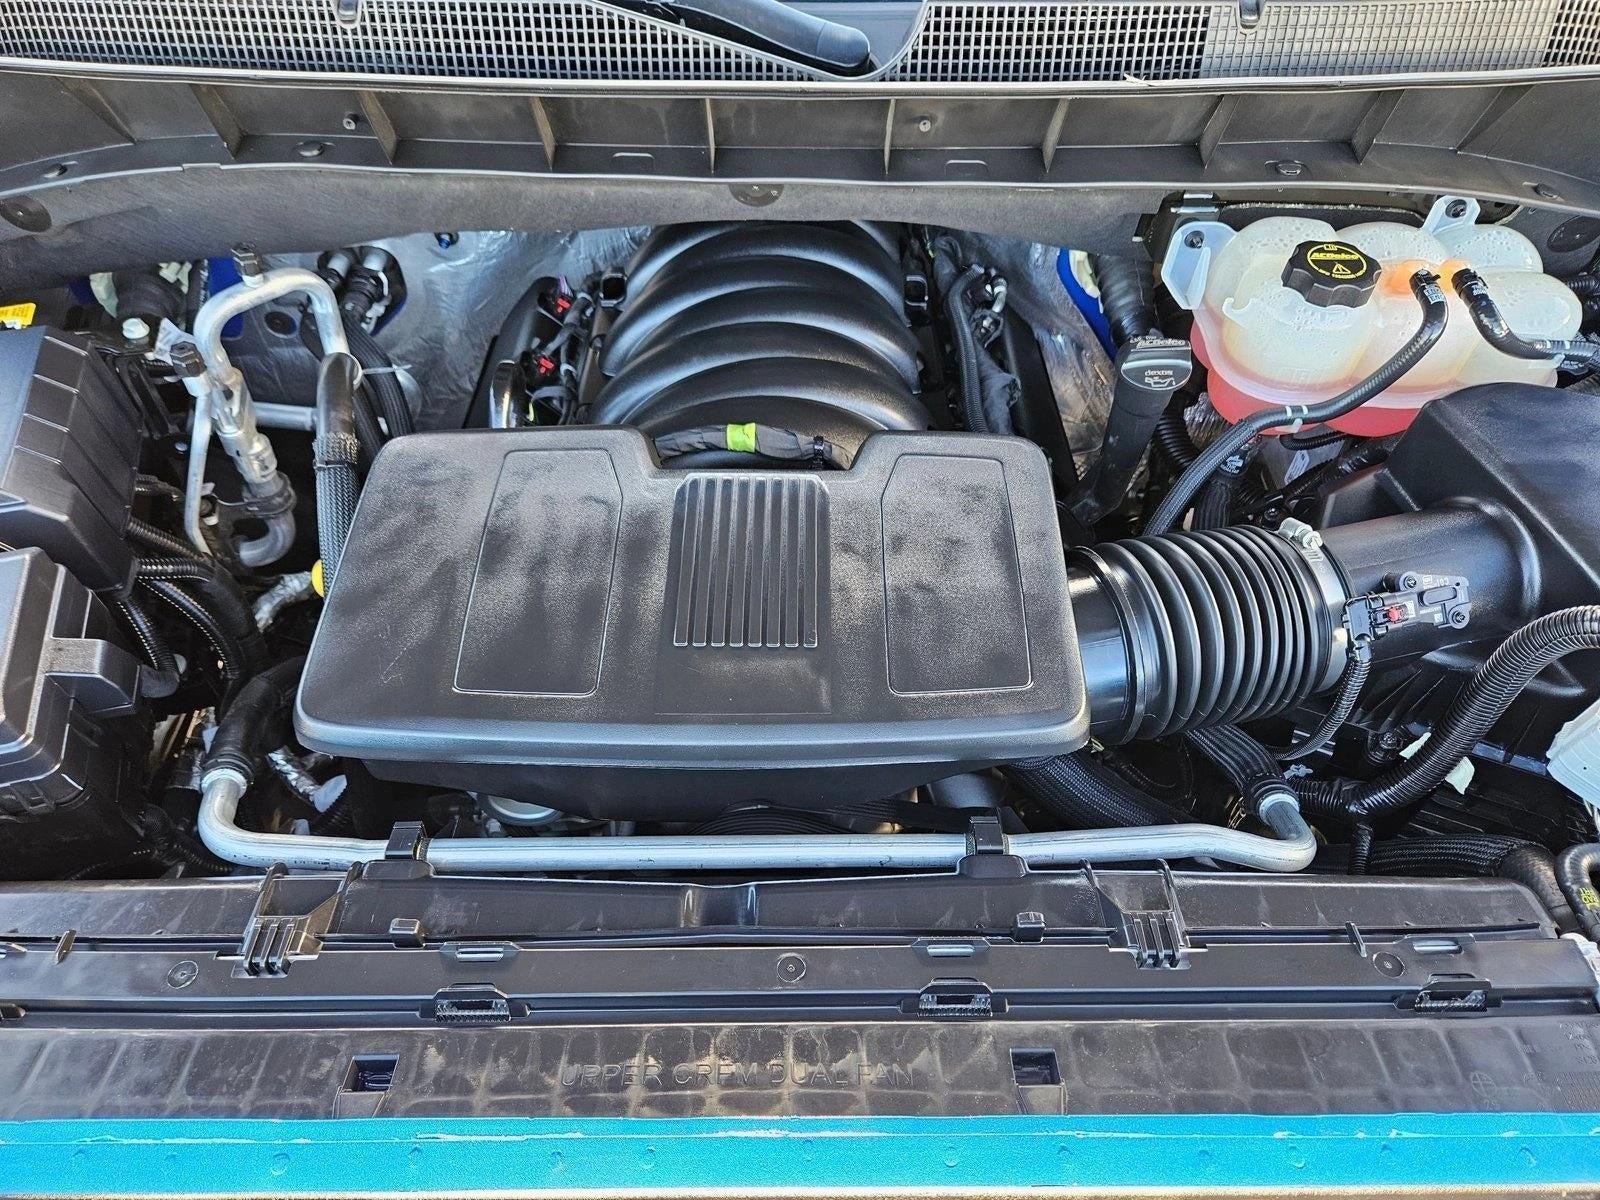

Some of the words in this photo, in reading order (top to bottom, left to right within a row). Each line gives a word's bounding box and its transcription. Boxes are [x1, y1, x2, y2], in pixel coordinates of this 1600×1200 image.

[561, 1064, 663, 1086] UPPER
[673, 1063, 757, 1086] CRFM
[770, 1063, 848, 1086] DUAL
[857, 1063, 914, 1086] FAN
